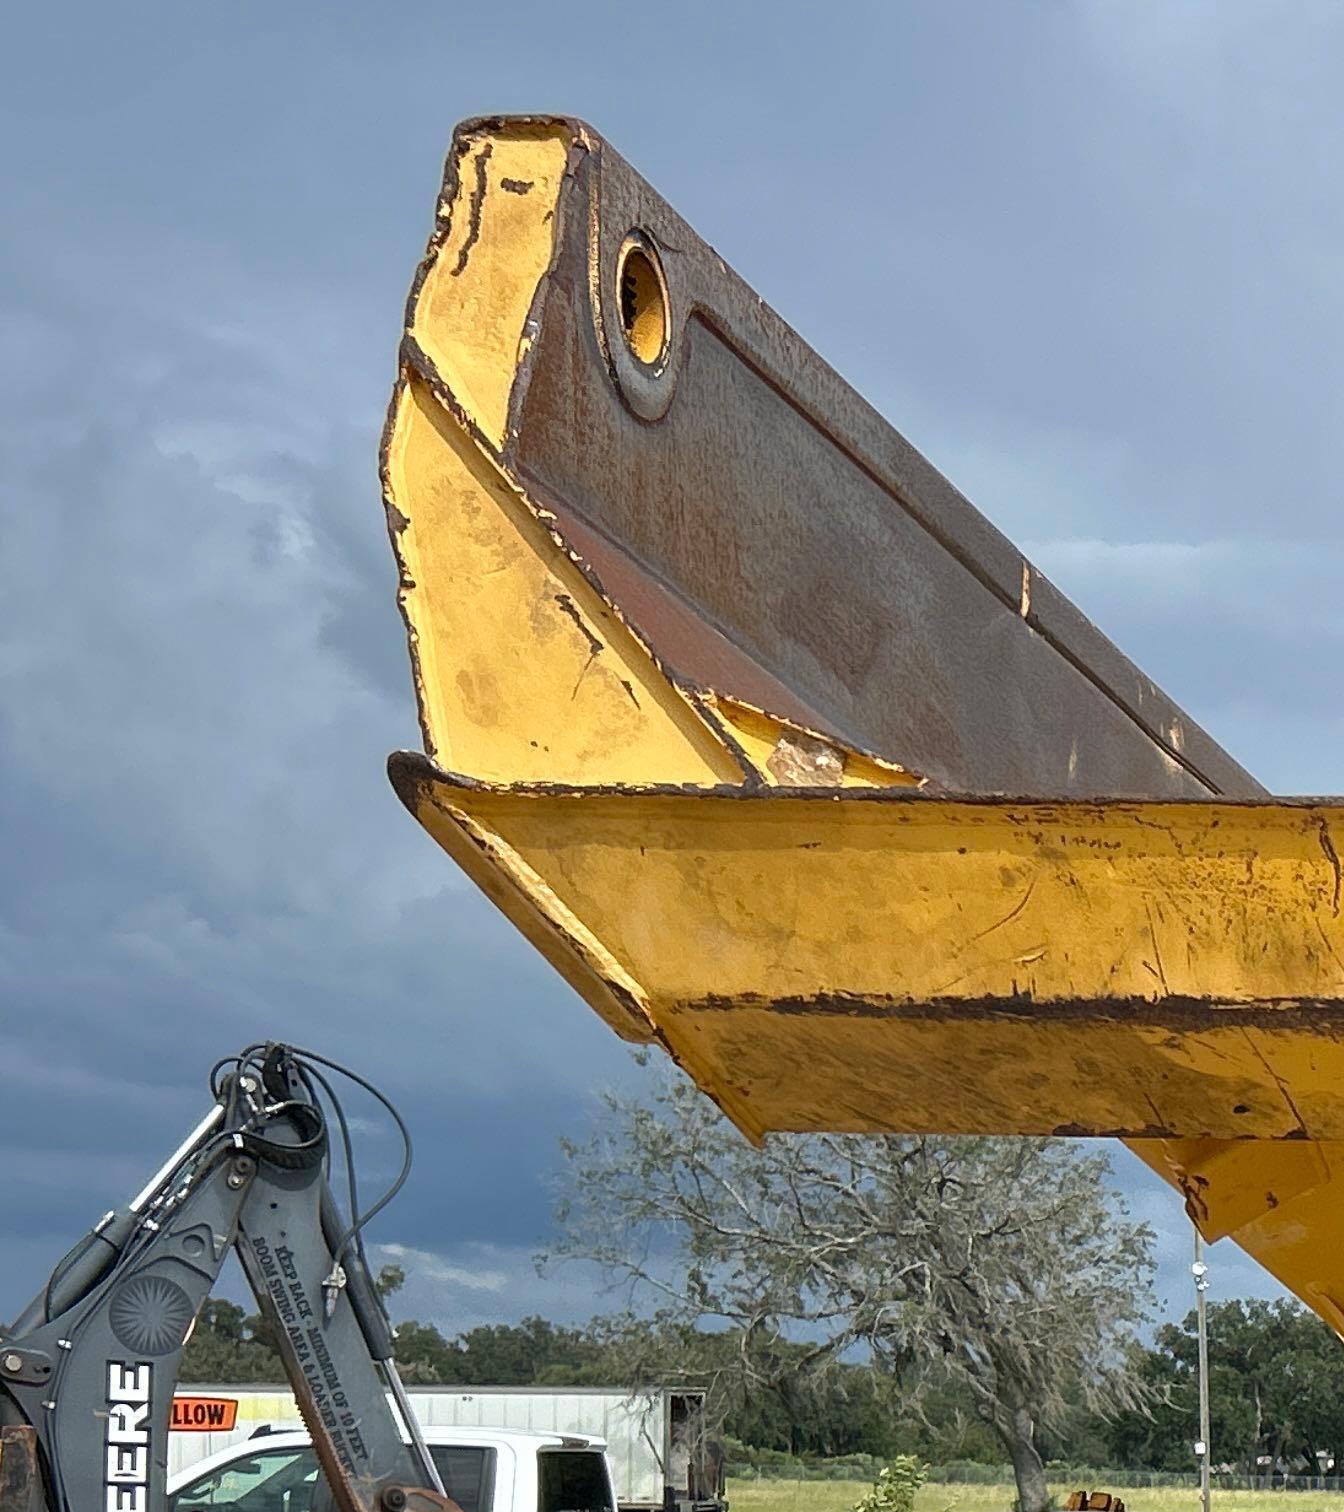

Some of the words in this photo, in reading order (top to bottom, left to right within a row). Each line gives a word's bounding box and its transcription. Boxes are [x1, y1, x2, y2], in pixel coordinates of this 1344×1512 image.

[252, 1236, 278, 1278] BOOM
[275, 1245, 298, 1280] KEEP
[268, 1279, 296, 1324] SWING
[288, 1281, 313, 1319] BACK
[287, 1325, 311, 1362] AREA
[306, 1327, 342, 1391] MINIMUM
[302, 1363, 316, 1374] &
[172, 1403, 225, 1425] LLOW
[308, 1375, 337, 1428] LOADER
[332, 1391, 349, 1408] OF
[340, 1412, 355, 1427] 10
[346, 1426, 369, 1460] FEET
